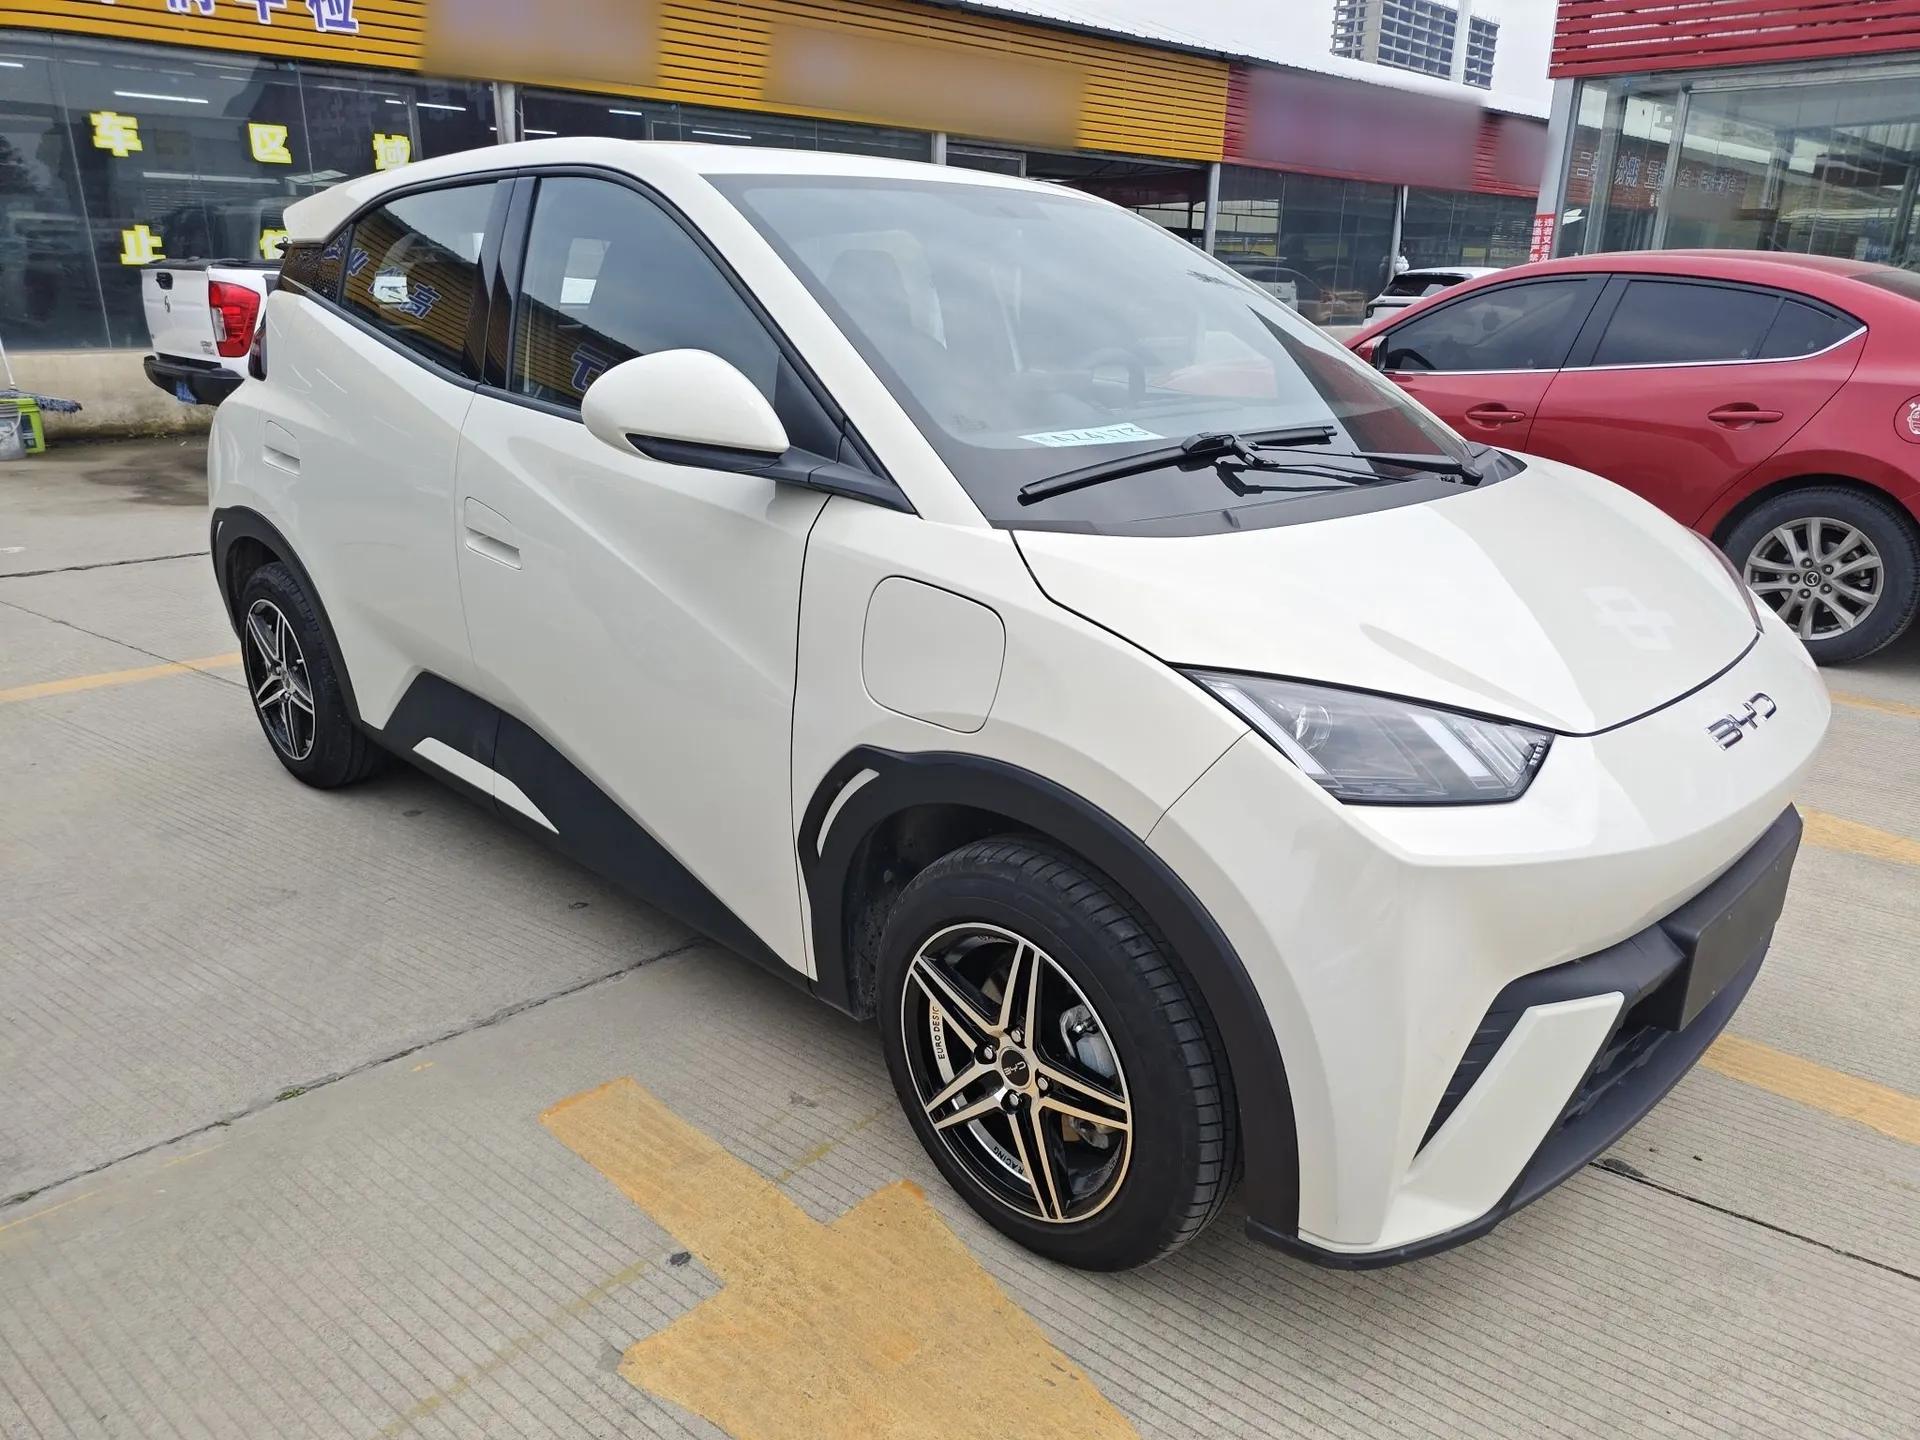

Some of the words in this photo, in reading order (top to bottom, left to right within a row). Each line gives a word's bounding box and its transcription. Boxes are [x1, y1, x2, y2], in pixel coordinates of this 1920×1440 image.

[1705, 692, 1777, 751] BYD
[934, 1034, 946, 1060] EURO
[1003, 1060, 1027, 1077] BYD
[993, 1145, 1025, 1176] RACING
